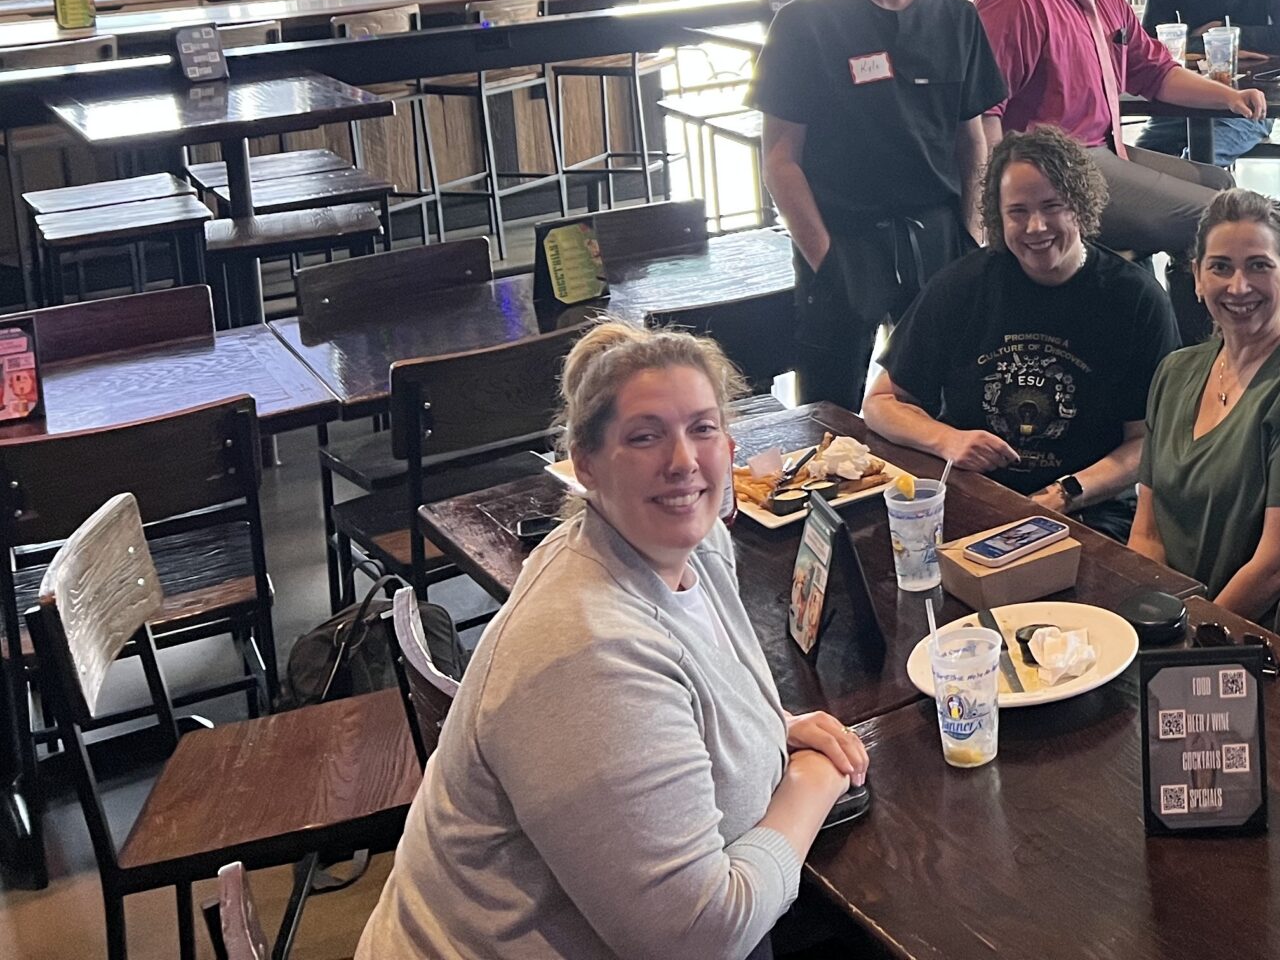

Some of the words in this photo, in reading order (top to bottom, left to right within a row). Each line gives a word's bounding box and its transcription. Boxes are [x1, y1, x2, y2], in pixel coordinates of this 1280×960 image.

[1004, 332, 1061, 345] PROMOTING
[977, 343, 1025, 365] CULTURE
[1028, 343, 1040, 351] OF
[1044, 344, 1092, 374] DISCOVERY
[1018, 375, 1046, 387] ESU
[1040, 460, 1062, 468] DAY
[1192, 676, 1212, 696] FOOD
[1187, 713, 1204, 733] BEER
[1210, 711, 1230, 732] WINE
[1182, 749, 1222, 771] COCKTAILS
[1189, 788, 1223, 808] SPECIALS
